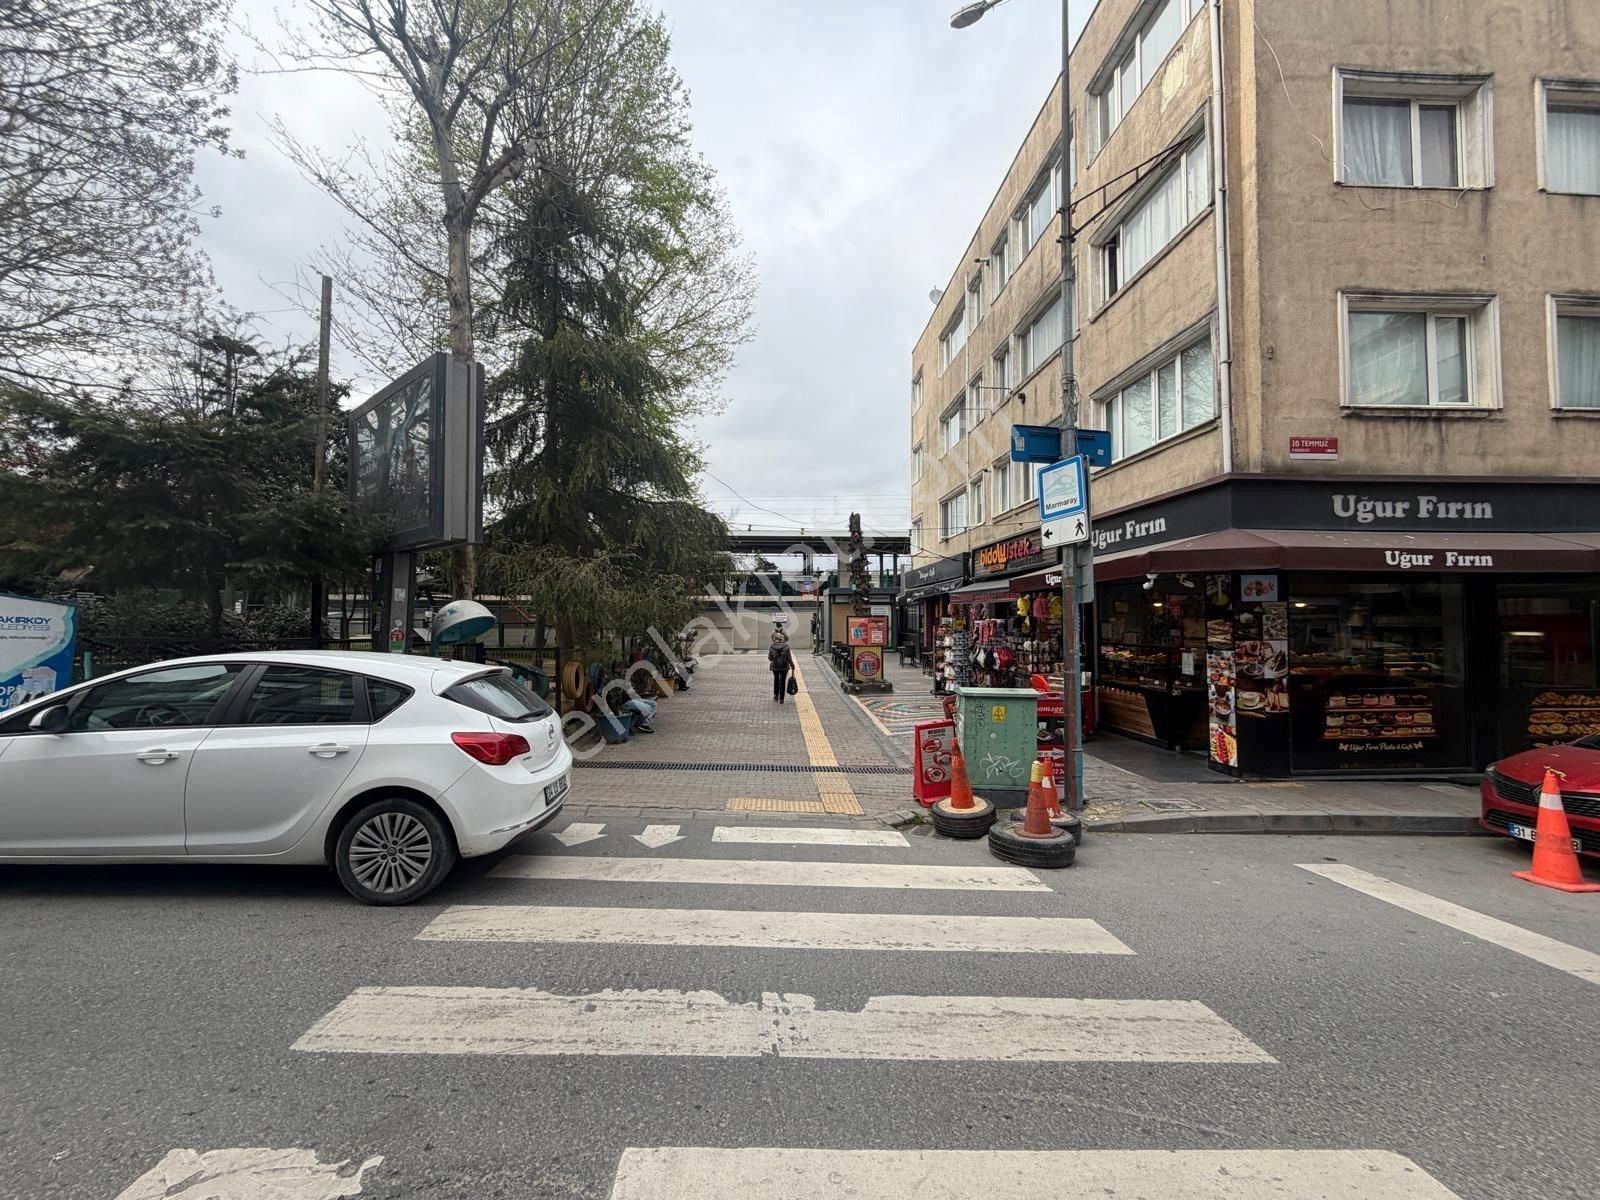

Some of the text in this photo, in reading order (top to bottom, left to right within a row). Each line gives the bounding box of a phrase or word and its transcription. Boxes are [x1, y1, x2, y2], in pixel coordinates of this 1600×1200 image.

[1291, 439, 1329, 448] 10 TEMMUZ
[1045, 496, 1078, 511] Marmaray
[1331, 494, 1493, 523] Uğur Fırın
[1091, 517, 1166, 550] Uğur Fırın
[1385, 550, 1493, 568] Uğur Fırın
[1045, 573, 1062, 586] Uğur
